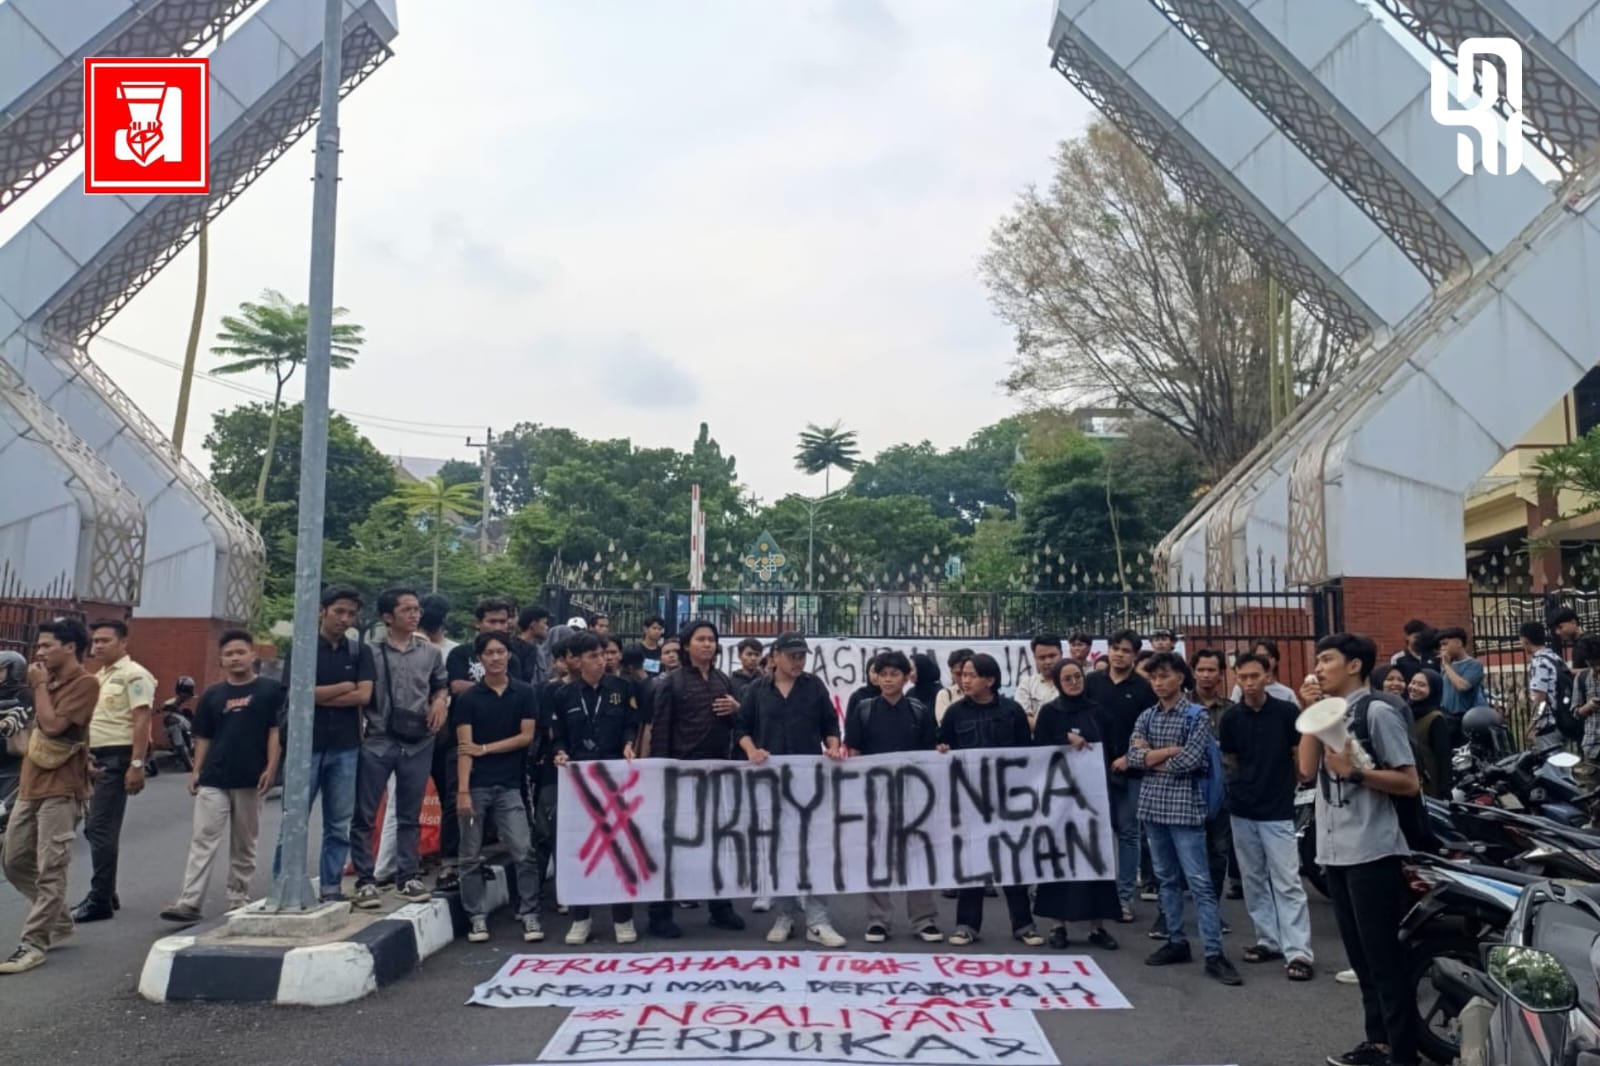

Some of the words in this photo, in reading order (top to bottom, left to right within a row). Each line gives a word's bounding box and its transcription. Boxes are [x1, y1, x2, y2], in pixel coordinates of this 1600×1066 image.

[949, 750, 1096, 824] NGA
[953, 819, 1109, 886] LIYAN
[509, 955, 800, 976] PERUSAHAAN
[816, 954, 921, 975] TIDAK
[933, 956, 1091, 978] PEDULI
[566, 1027, 980, 1057] BERDUKA
